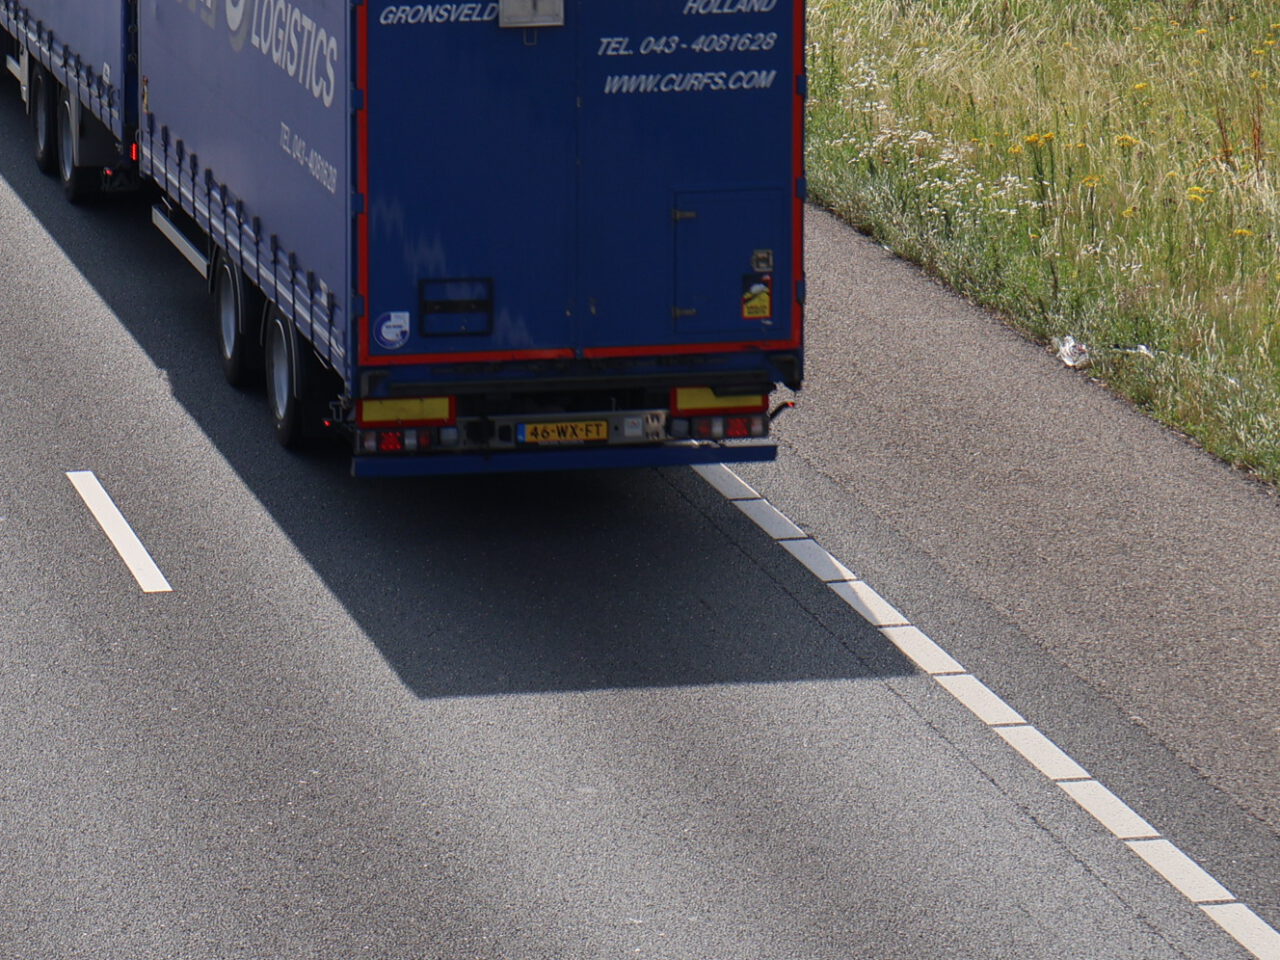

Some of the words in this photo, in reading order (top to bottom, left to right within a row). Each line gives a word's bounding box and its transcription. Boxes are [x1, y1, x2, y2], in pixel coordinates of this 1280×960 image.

[380, 3, 499, 24] GRONSVELD
[597, 37, 634, 55] TEL.
[604, 70, 777, 94] WWW.CURFS.COM
